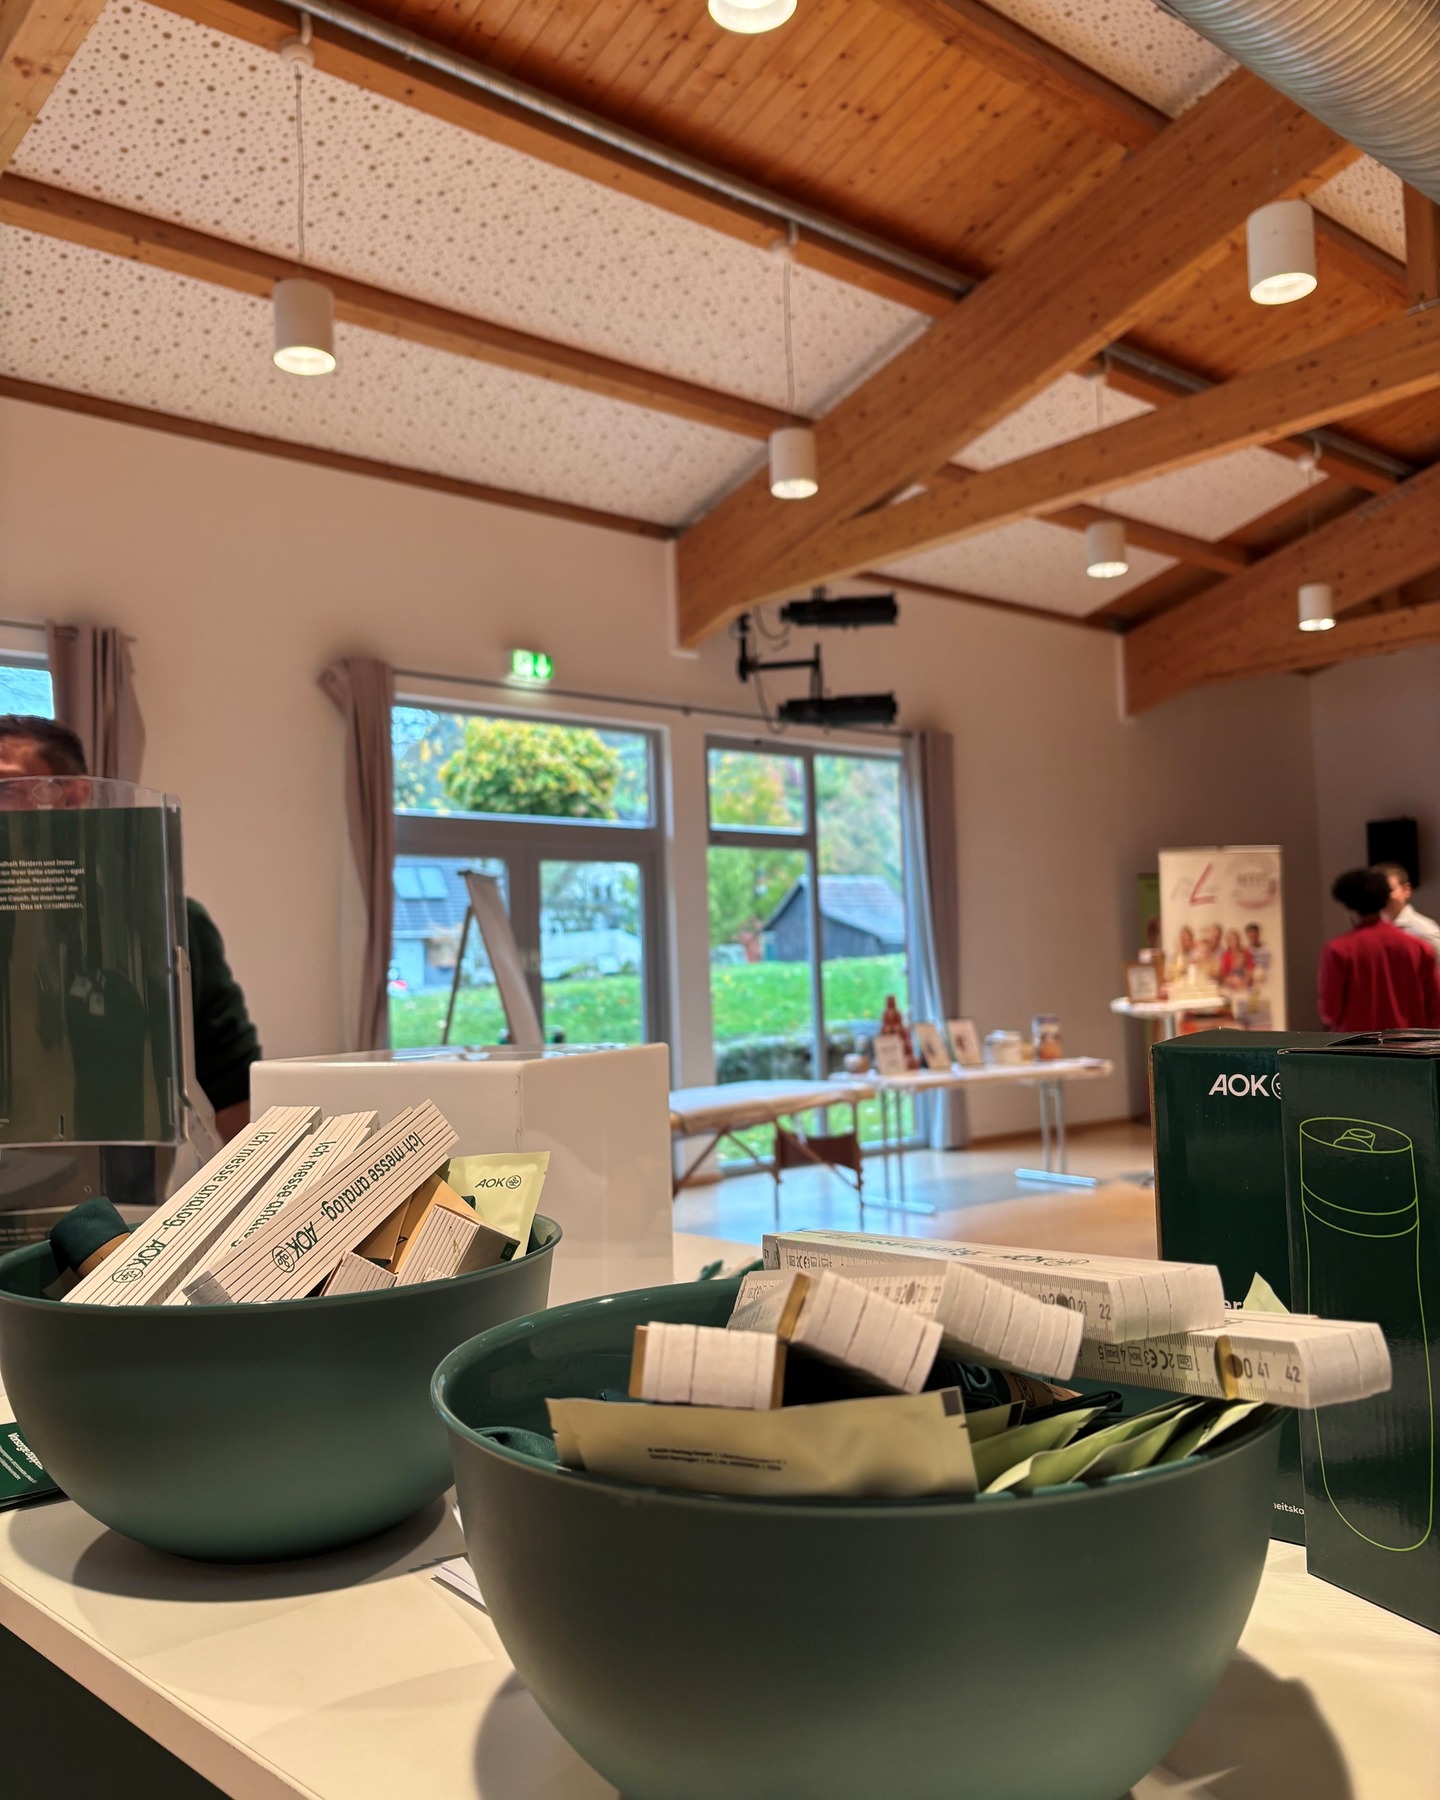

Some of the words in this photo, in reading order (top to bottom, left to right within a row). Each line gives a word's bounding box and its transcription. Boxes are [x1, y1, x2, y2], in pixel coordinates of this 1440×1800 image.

[1208, 1073, 1270, 1097] AOK
[248, 1130, 277, 1147] Ich
[314, 1139, 337, 1158] Ich
[406, 1131, 426, 1153] Ich
[213, 1147, 255, 1182] messe
[276, 1156, 321, 1198] messe
[368, 1147, 407, 1182] messe
[475, 1177, 506, 1189] AOK
[162, 1184, 220, 1232] analog.
[320, 1175, 371, 1222] analog.
[126, 1238, 168, 1269] AOK
[285, 1221, 319, 1260] AOK
[1099, 1303, 1112, 1321] 22
[1258, 1361, 1270, 1379] 41
[1285, 1365, 1302, 1383] 42
